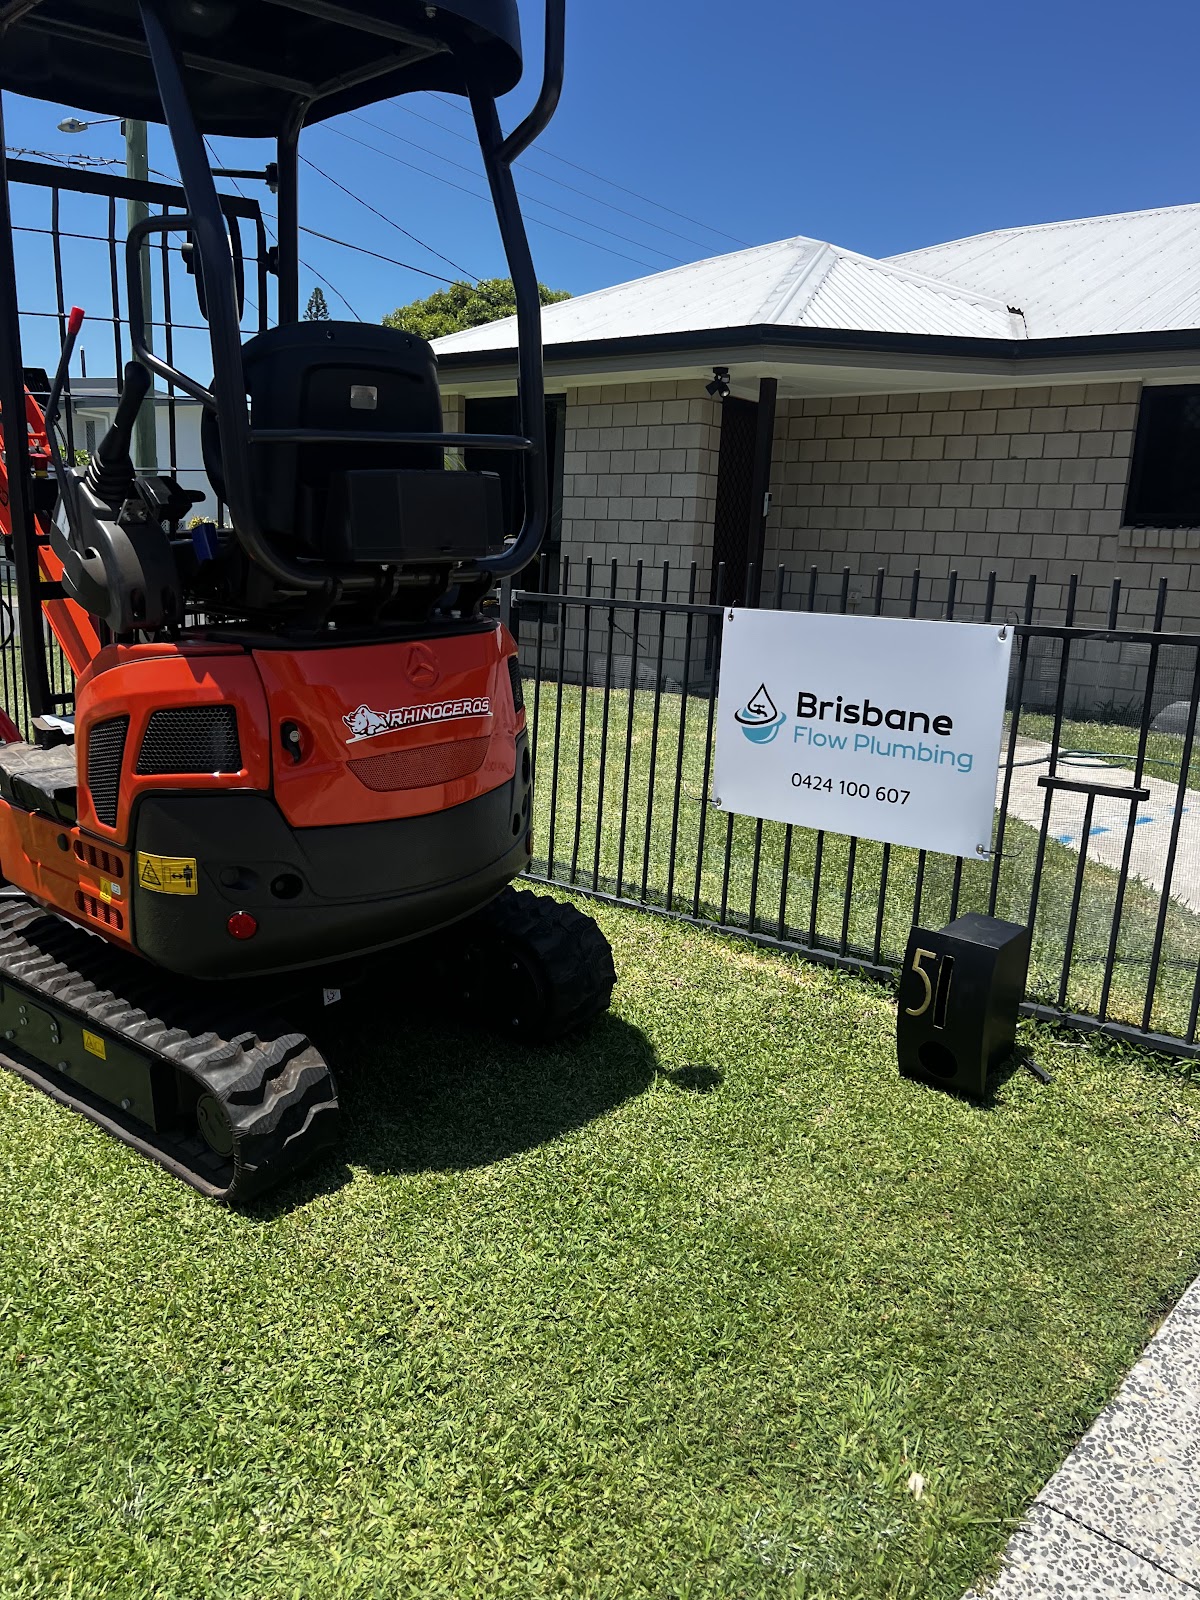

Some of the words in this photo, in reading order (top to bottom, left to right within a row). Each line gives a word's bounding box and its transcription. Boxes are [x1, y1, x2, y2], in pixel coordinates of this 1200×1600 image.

[390, 699, 490, 728] RHINOCEROS
[796, 691, 954, 736] Brisbane
[793, 726, 848, 750] Flow
[853, 733, 974, 773] Plumbing
[791, 772, 834, 793] 0424
[839, 780, 871, 799] 100
[875, 786, 911, 805] 607
